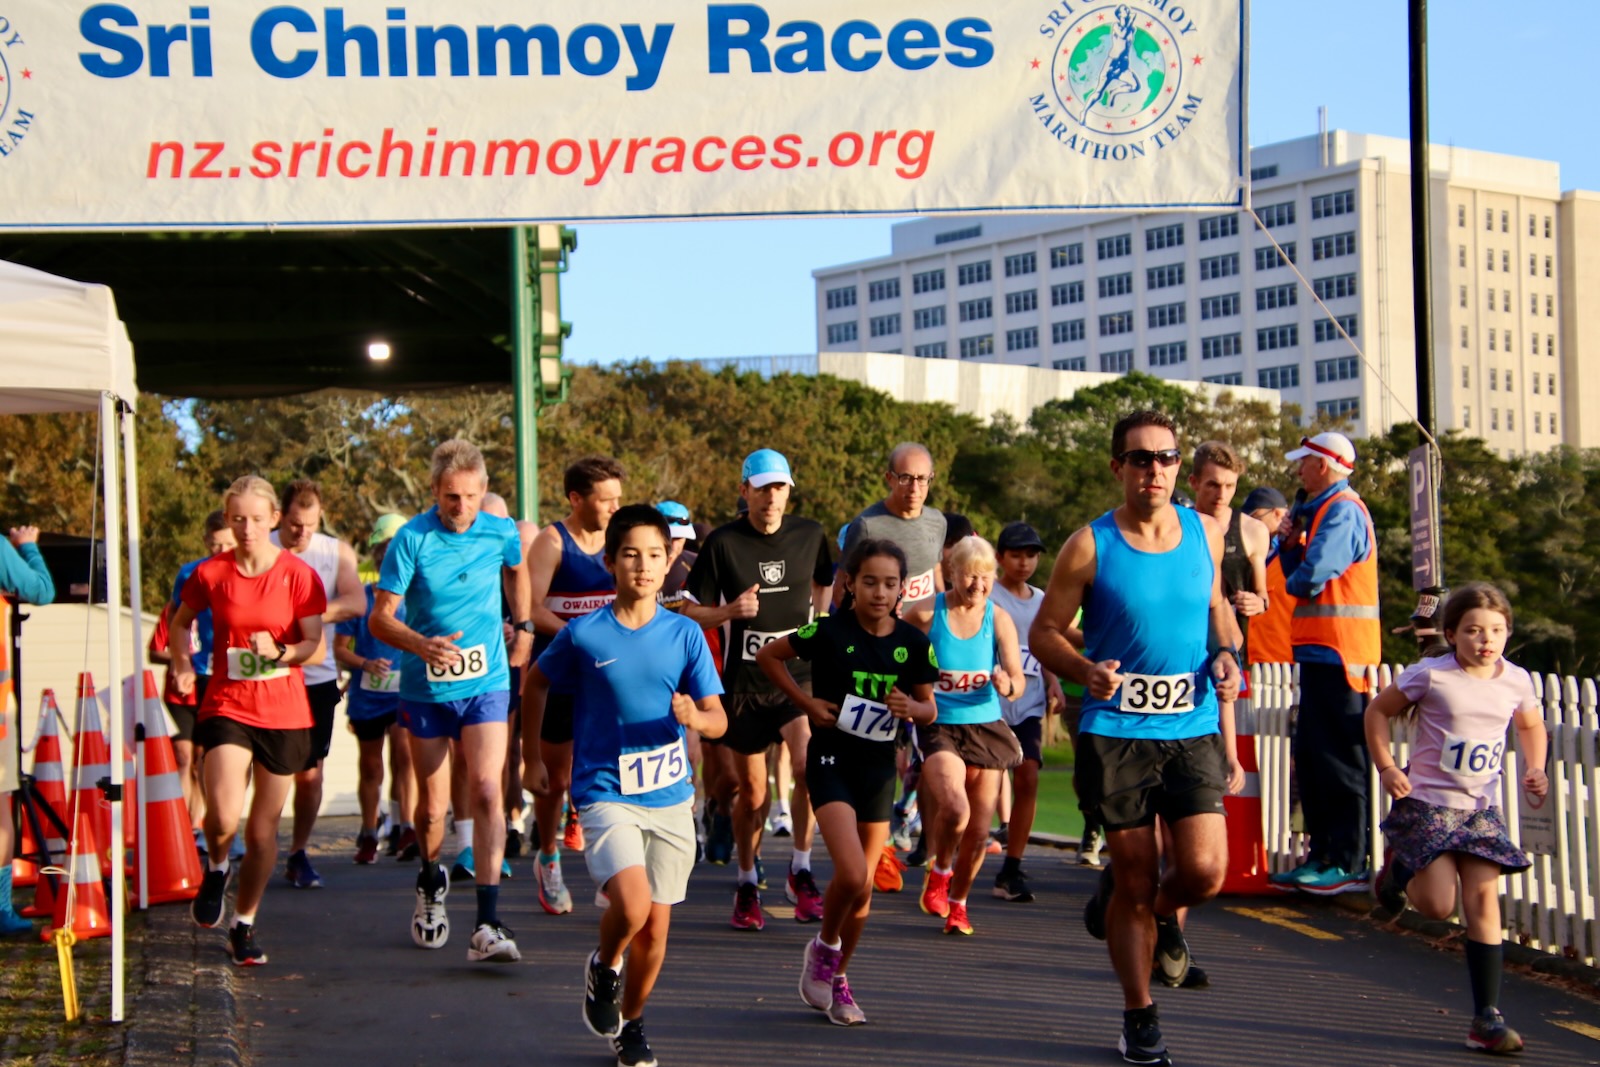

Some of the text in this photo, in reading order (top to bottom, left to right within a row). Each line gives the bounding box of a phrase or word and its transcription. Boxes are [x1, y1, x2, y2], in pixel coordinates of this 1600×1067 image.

[79, 4, 995, 91] Sri Chinmoy Races
[1029, 92, 1203, 161] MARATHON TEAM
[147, 128, 935, 186] nz.srichinmoyraces.org
[1413, 461, 1425, 512] P
[902, 575, 932, 599] 52
[939, 672, 988, 692] 549
[1128, 678, 1190, 710] 392
[850, 703, 894, 736] 174
[628, 746, 683, 788] 175
[1450, 741, 1503, 773] 168
